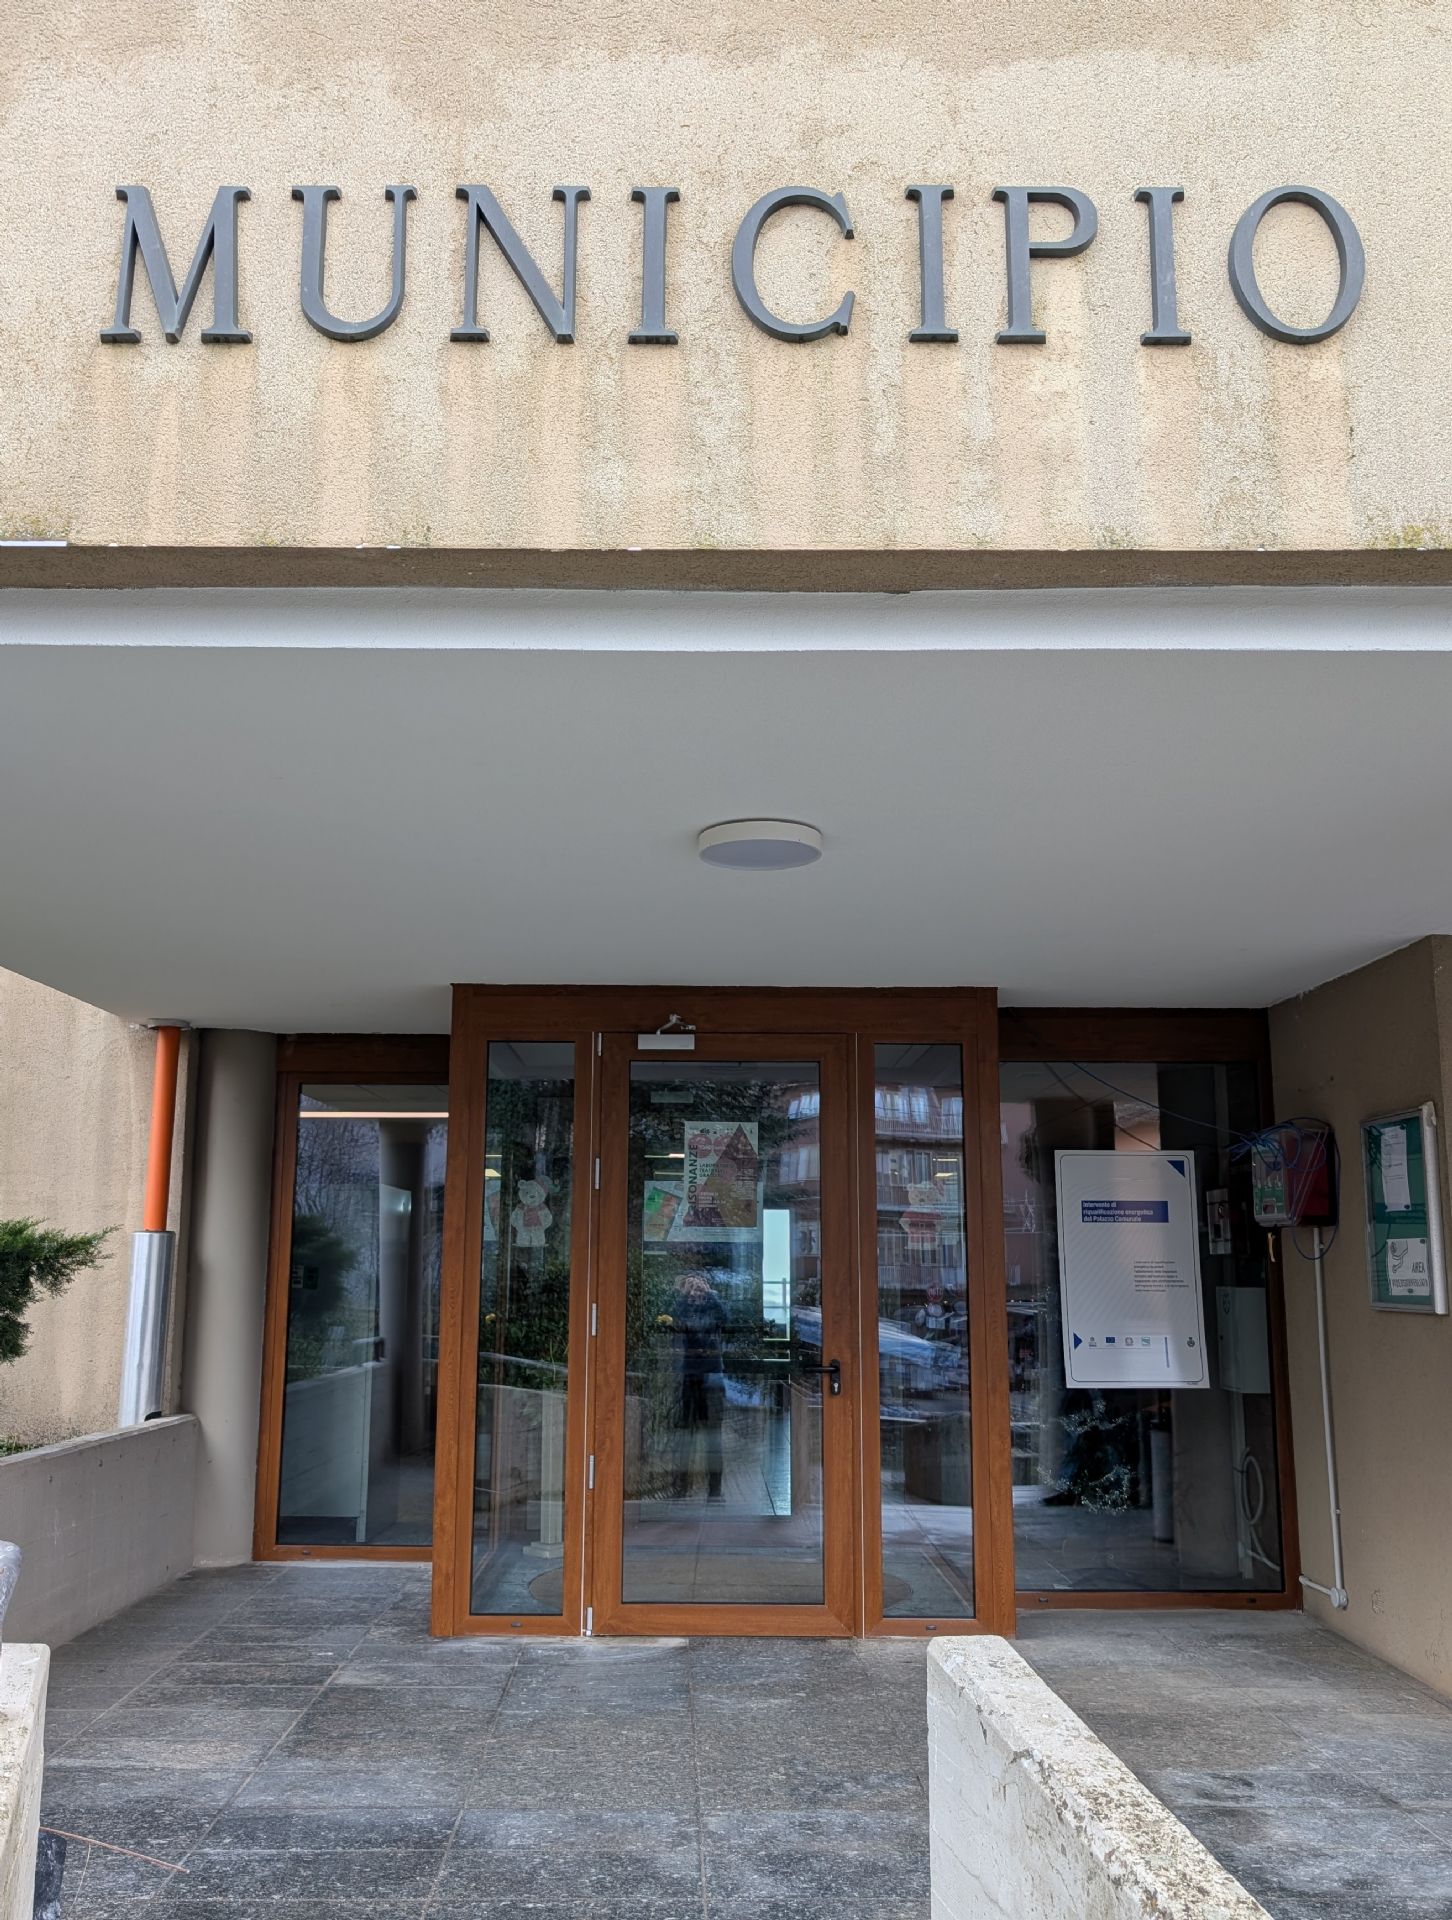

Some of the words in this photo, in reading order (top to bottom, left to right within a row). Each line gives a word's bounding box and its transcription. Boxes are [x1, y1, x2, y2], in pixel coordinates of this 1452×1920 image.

[100, 184, 1366, 346] MUNICIPIO
[1083, 1208, 1124, 1216] riqualificazione
[1412, 1262, 1426, 1273] AREA
